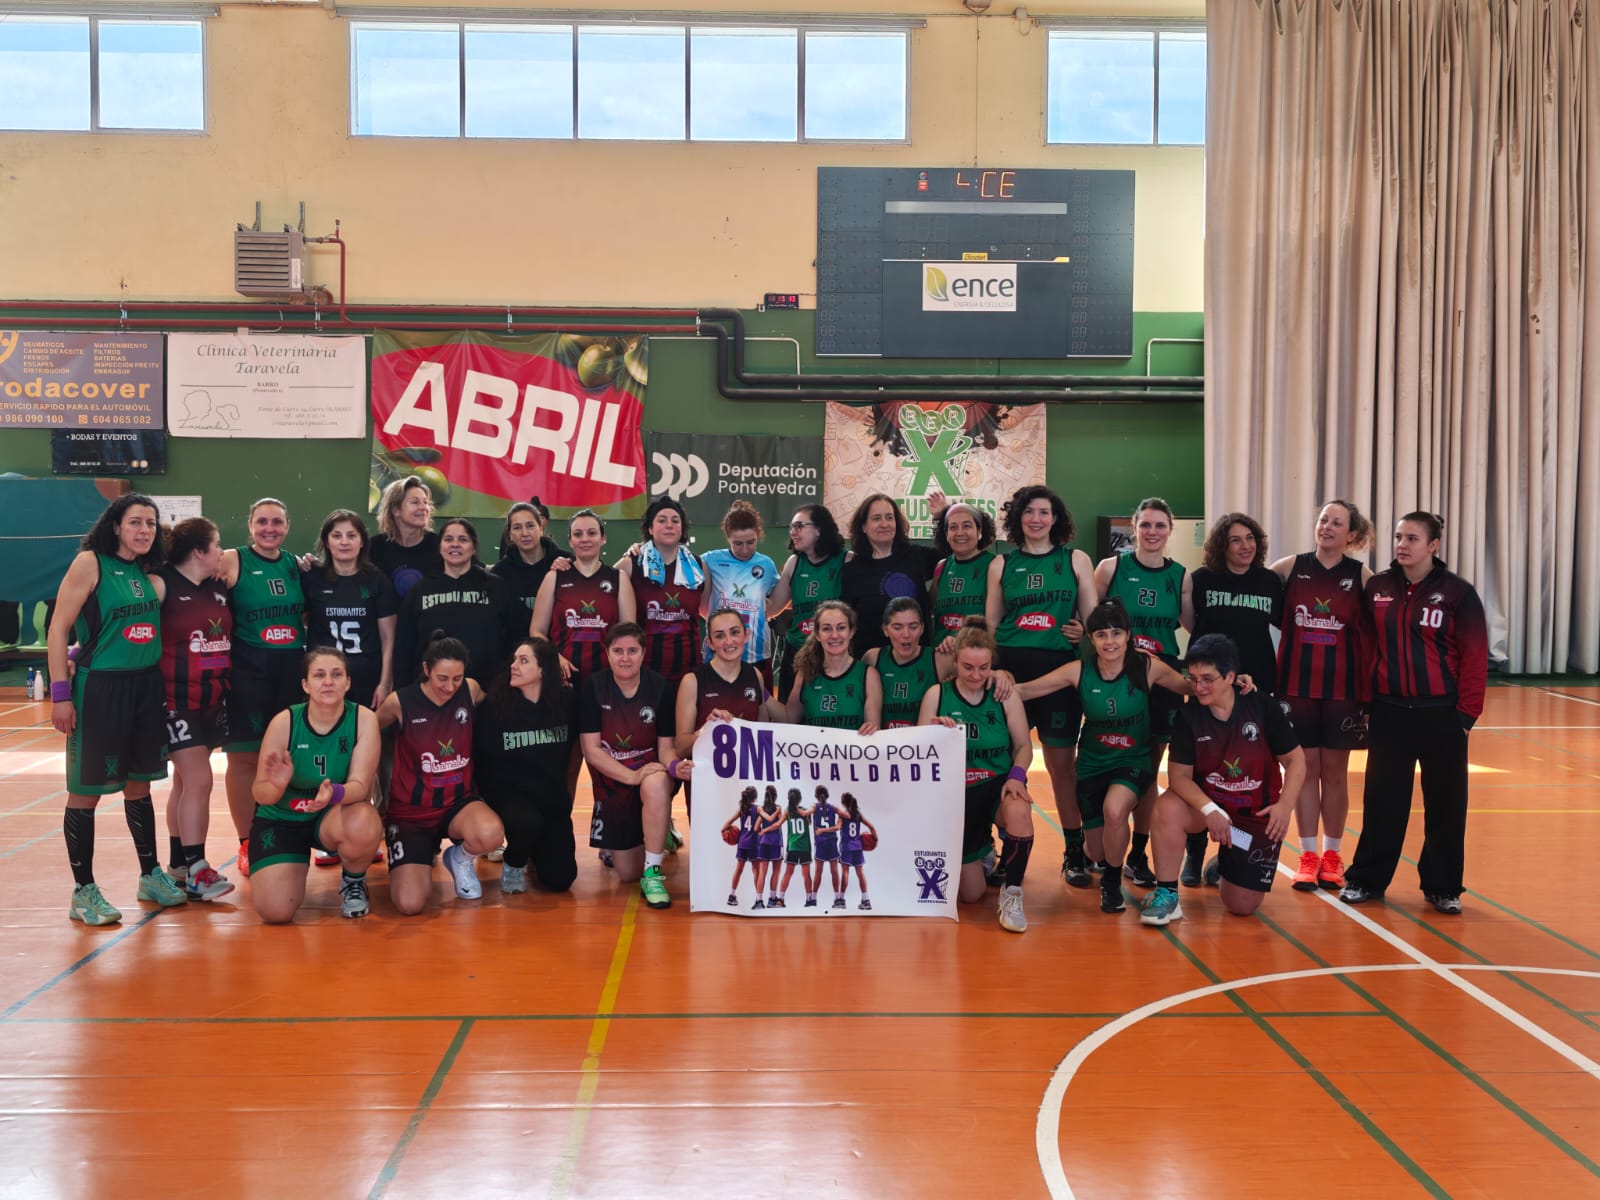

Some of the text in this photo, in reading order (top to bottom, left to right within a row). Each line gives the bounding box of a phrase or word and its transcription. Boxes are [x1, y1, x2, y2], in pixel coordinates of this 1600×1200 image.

[952, 278, 1015, 298] ence
[251, 344, 337, 360] Veterinaria
[234, 361, 300, 376] Taravela
[0, 402, 32, 410] ERVICIO
[67, 403, 89, 411] PARA
[5, 414, 23, 424] 986
[383, 360, 637, 489] ABRIL
[102, 433, 138, 441] EVENTOS
[719, 462, 818, 482] Deputación
[719, 480, 817, 496] Pontevedra
[267, 578, 289, 597] 16
[1026, 573, 1044, 591] 19
[1138, 588, 1158, 608] 23
[326, 607, 367, 617] ESTUDIANTES
[1420, 607, 1443, 629] 10
[1019, 615, 1052, 628] ABRIL
[330, 621, 363, 654] 15
[892, 682, 909, 699] 14
[820, 695, 838, 713] 22
[1105, 697, 1118, 718] 3
[166, 719, 192, 744] 12
[712, 724, 775, 782] 8M
[776, 742, 939, 761] XOGANDO POLA
[313, 754, 327, 777] 4
[776, 761, 941, 783] IGUALDADE
[743, 815, 752, 832] 4
[789, 818, 805, 835] 10
[849, 822, 858, 838] 8
